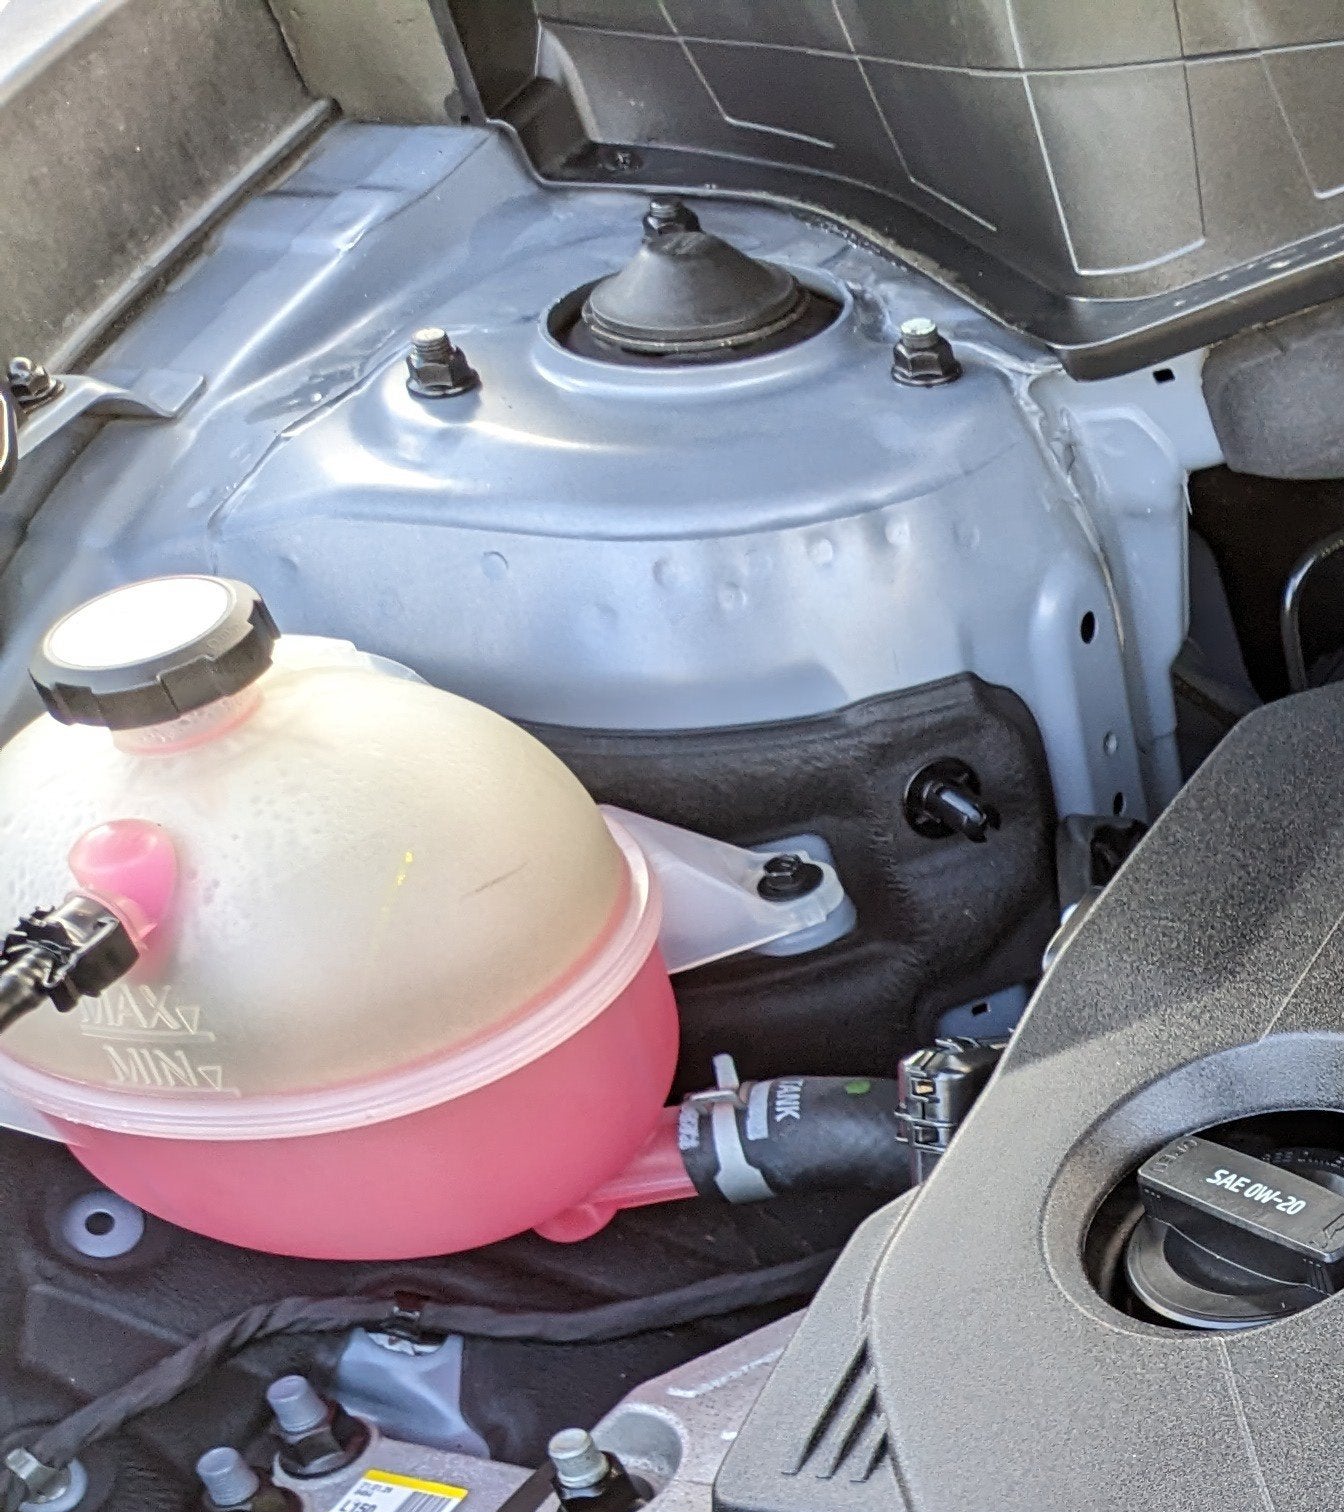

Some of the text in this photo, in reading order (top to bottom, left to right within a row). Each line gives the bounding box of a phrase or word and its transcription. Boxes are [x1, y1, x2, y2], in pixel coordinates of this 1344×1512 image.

[78, 983, 182, 1030] MAX
[102, 1044, 199, 1088] MIN
[774, 1079, 804, 1123] TANK
[1205, 1168, 1245, 1194] SAE
[1243, 1182, 1307, 1216] 0W-20
